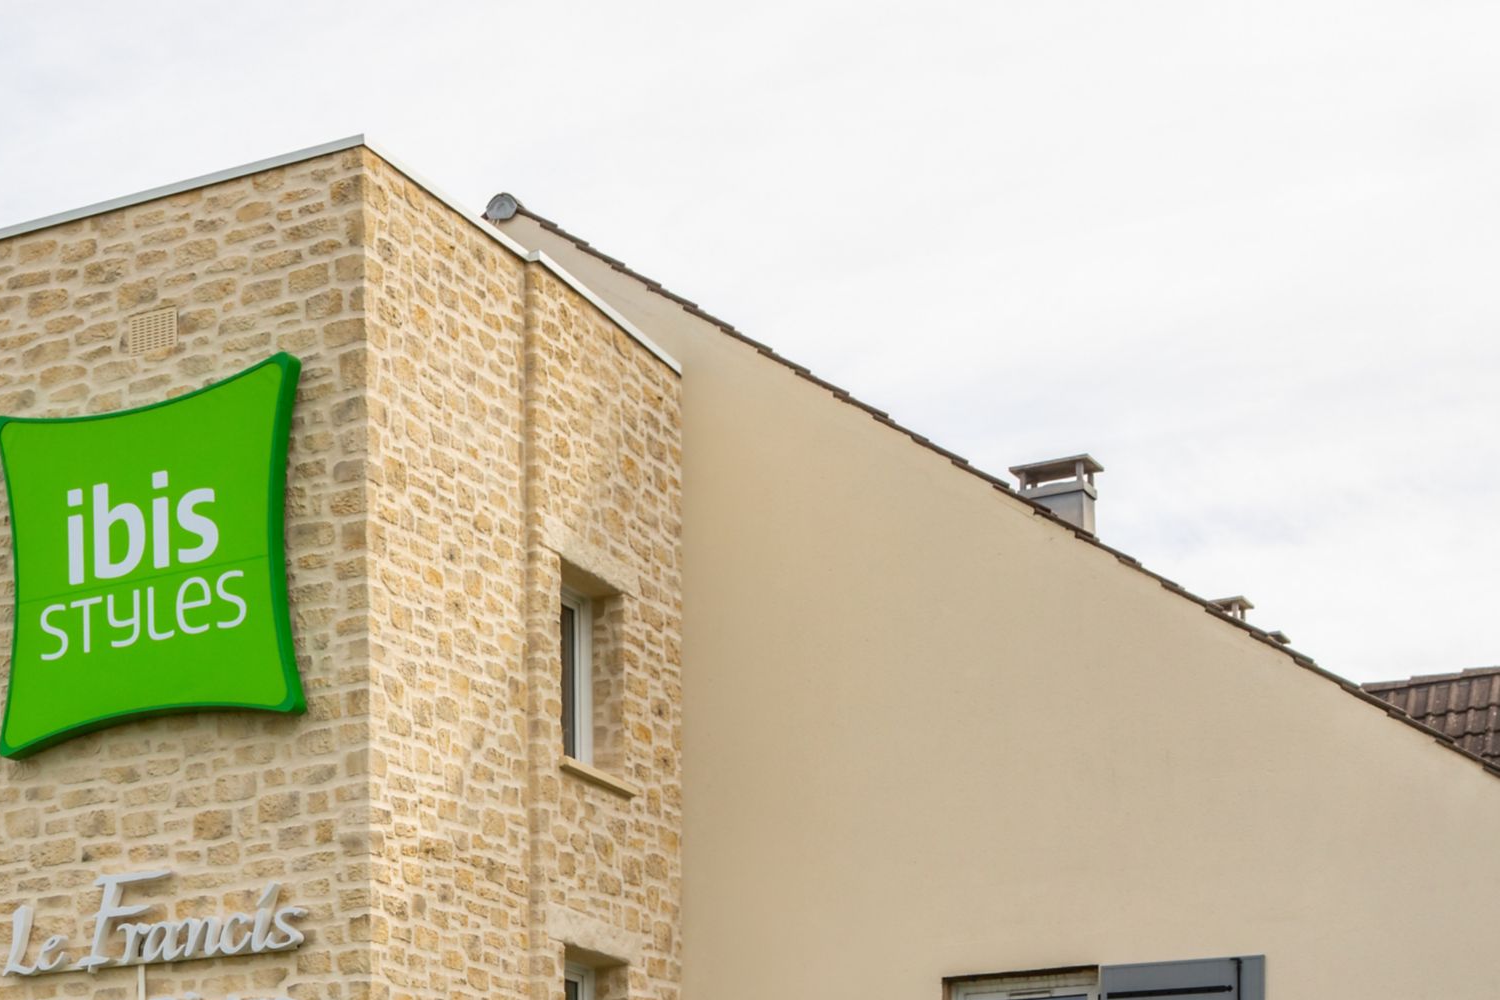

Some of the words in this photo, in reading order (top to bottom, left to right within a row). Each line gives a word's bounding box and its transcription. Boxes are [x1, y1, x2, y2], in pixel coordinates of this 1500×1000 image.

[67, 470, 219, 585] ibis
[2, 904, 69, 977] Le
[77, 870, 309, 973] Francis
